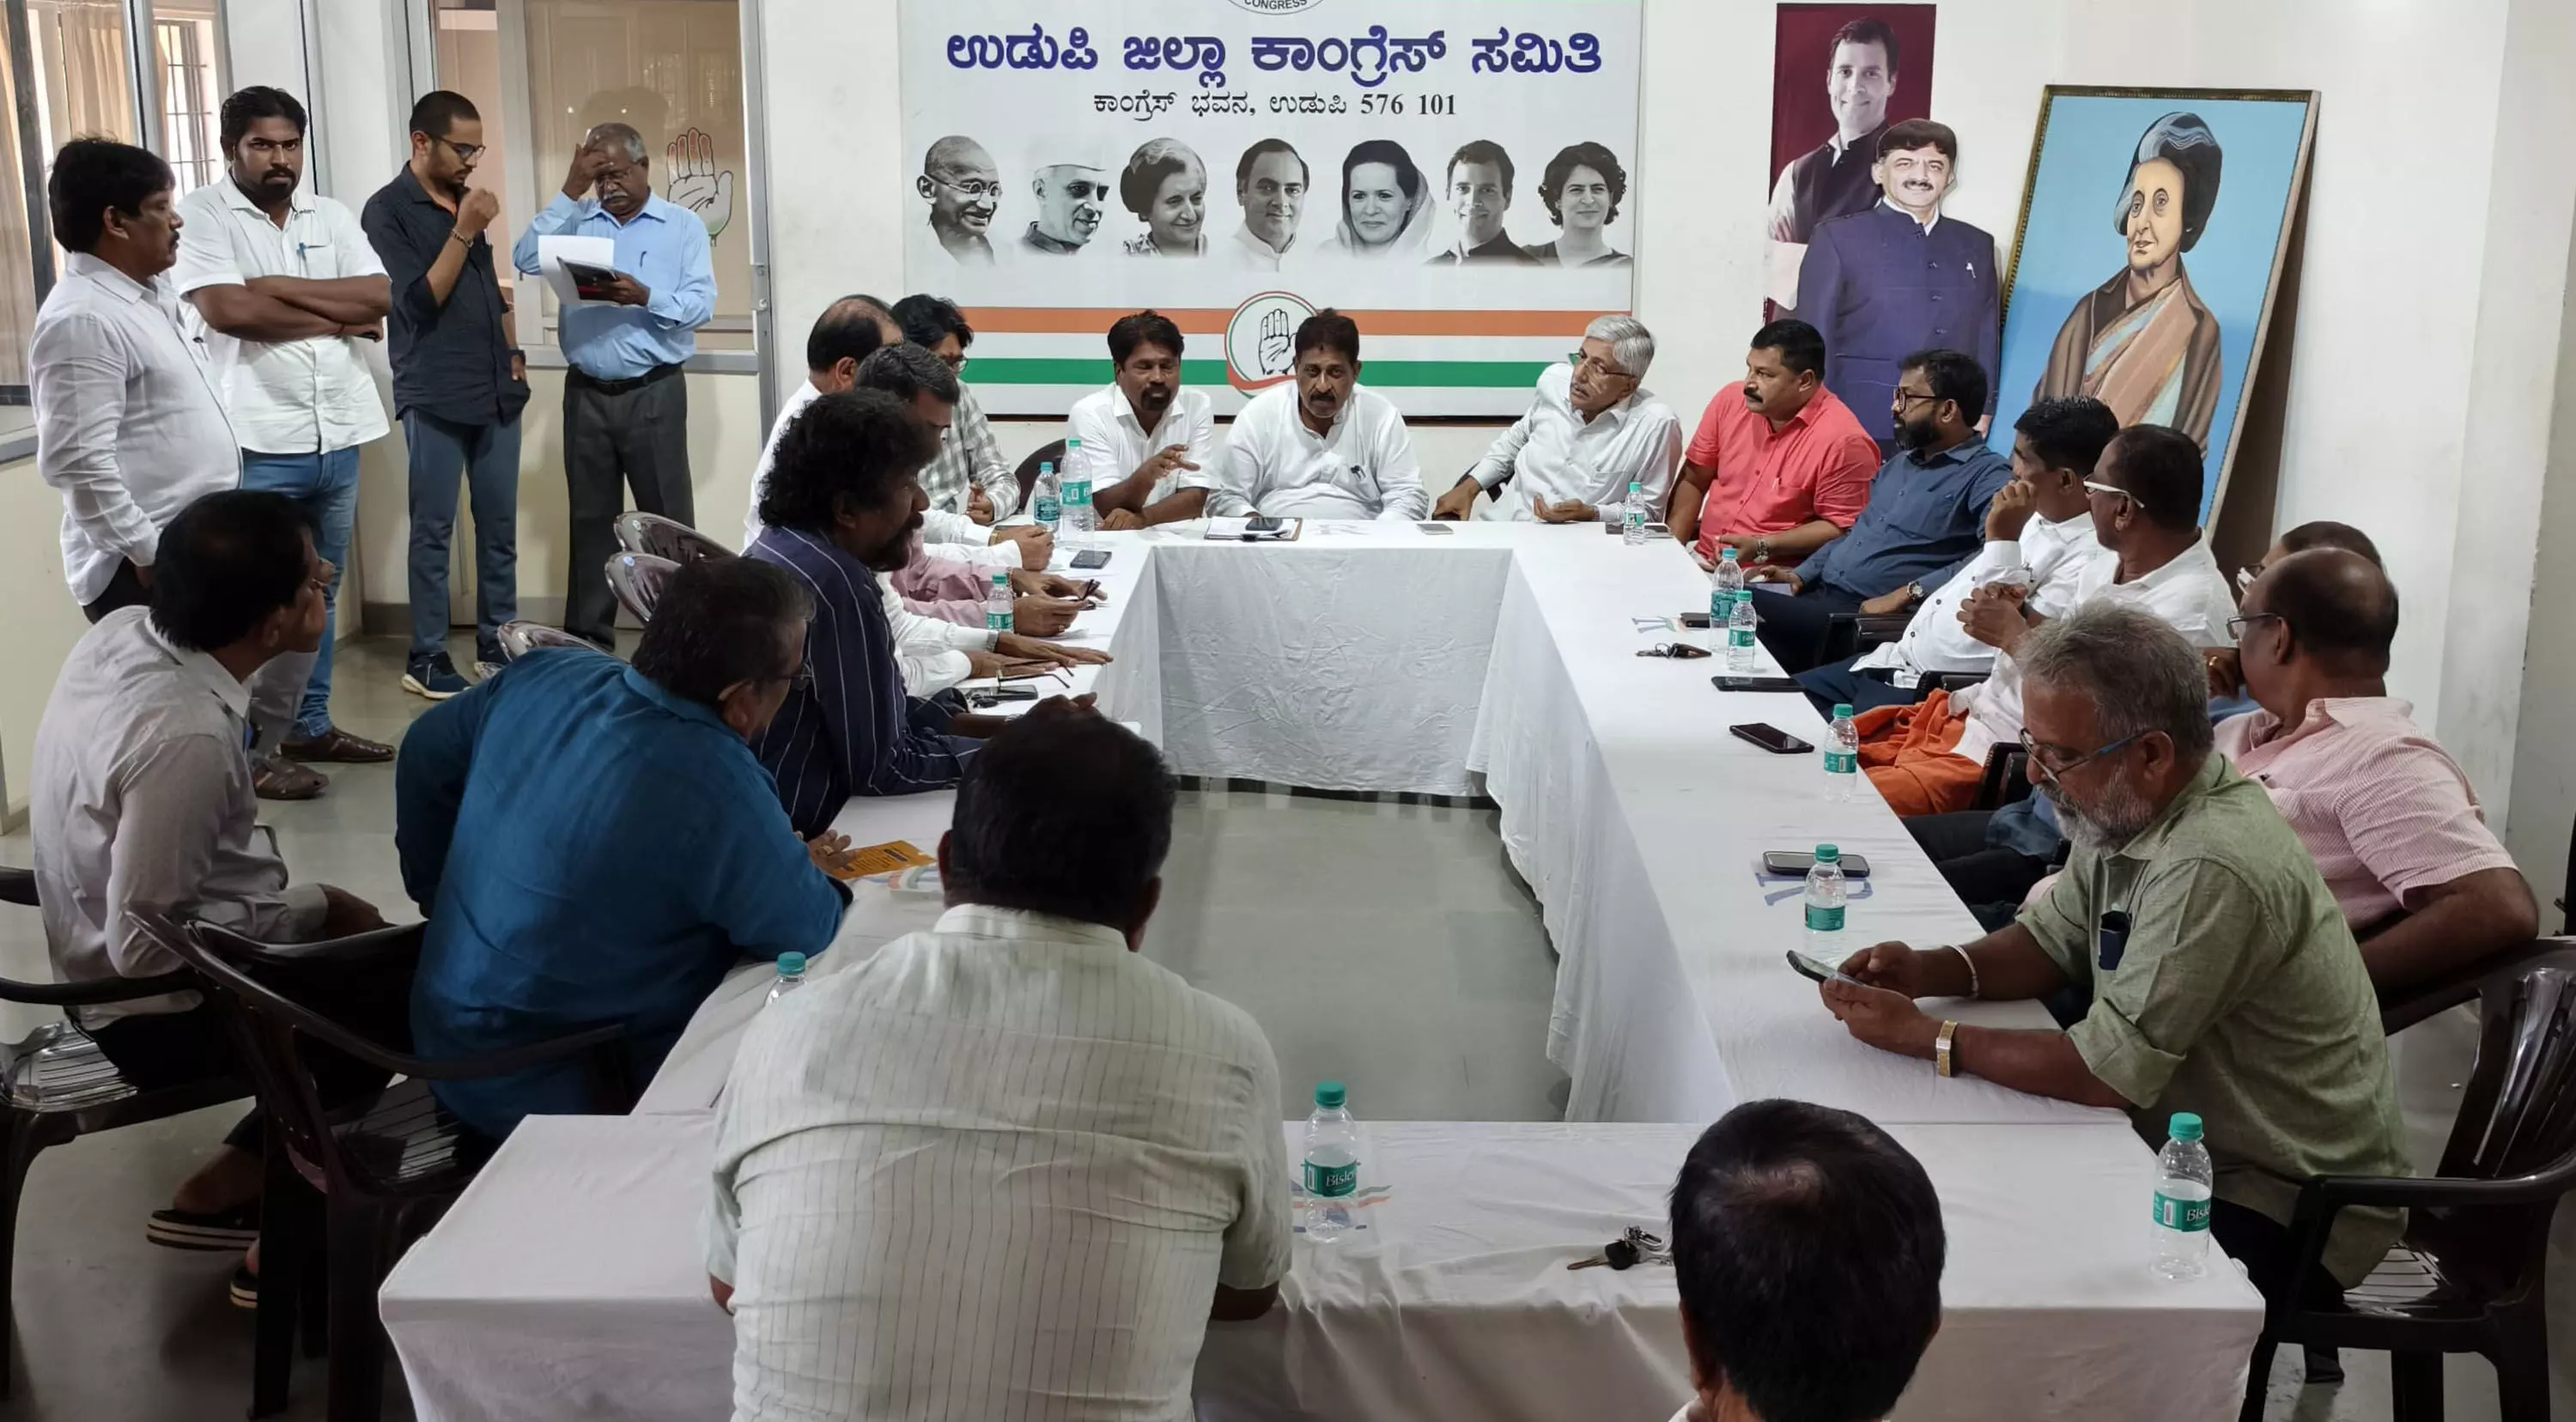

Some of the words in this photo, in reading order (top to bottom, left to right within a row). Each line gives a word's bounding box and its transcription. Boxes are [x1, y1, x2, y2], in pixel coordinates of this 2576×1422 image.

[946, 22, 1099, 70] ಉಡುಪಿ
[1123, 36, 1226, 88] ಜಿಲ್ಲಾ
[1250, 24, 1447, 88] ಕಾಂಗ್ರೆಸ್
[1471, 26, 1602, 74] ಸಮಿತಿ
[1093, 89, 1177, 122] ಕಾಂಗ್ರೆಸ್
[1191, 91, 1256, 118] ಭವನ,
[1269, 92, 1347, 114] ಉಡುಪಿ
[1360, 93, 1404, 115] 576
[1419, 94, 1455, 115] 101
